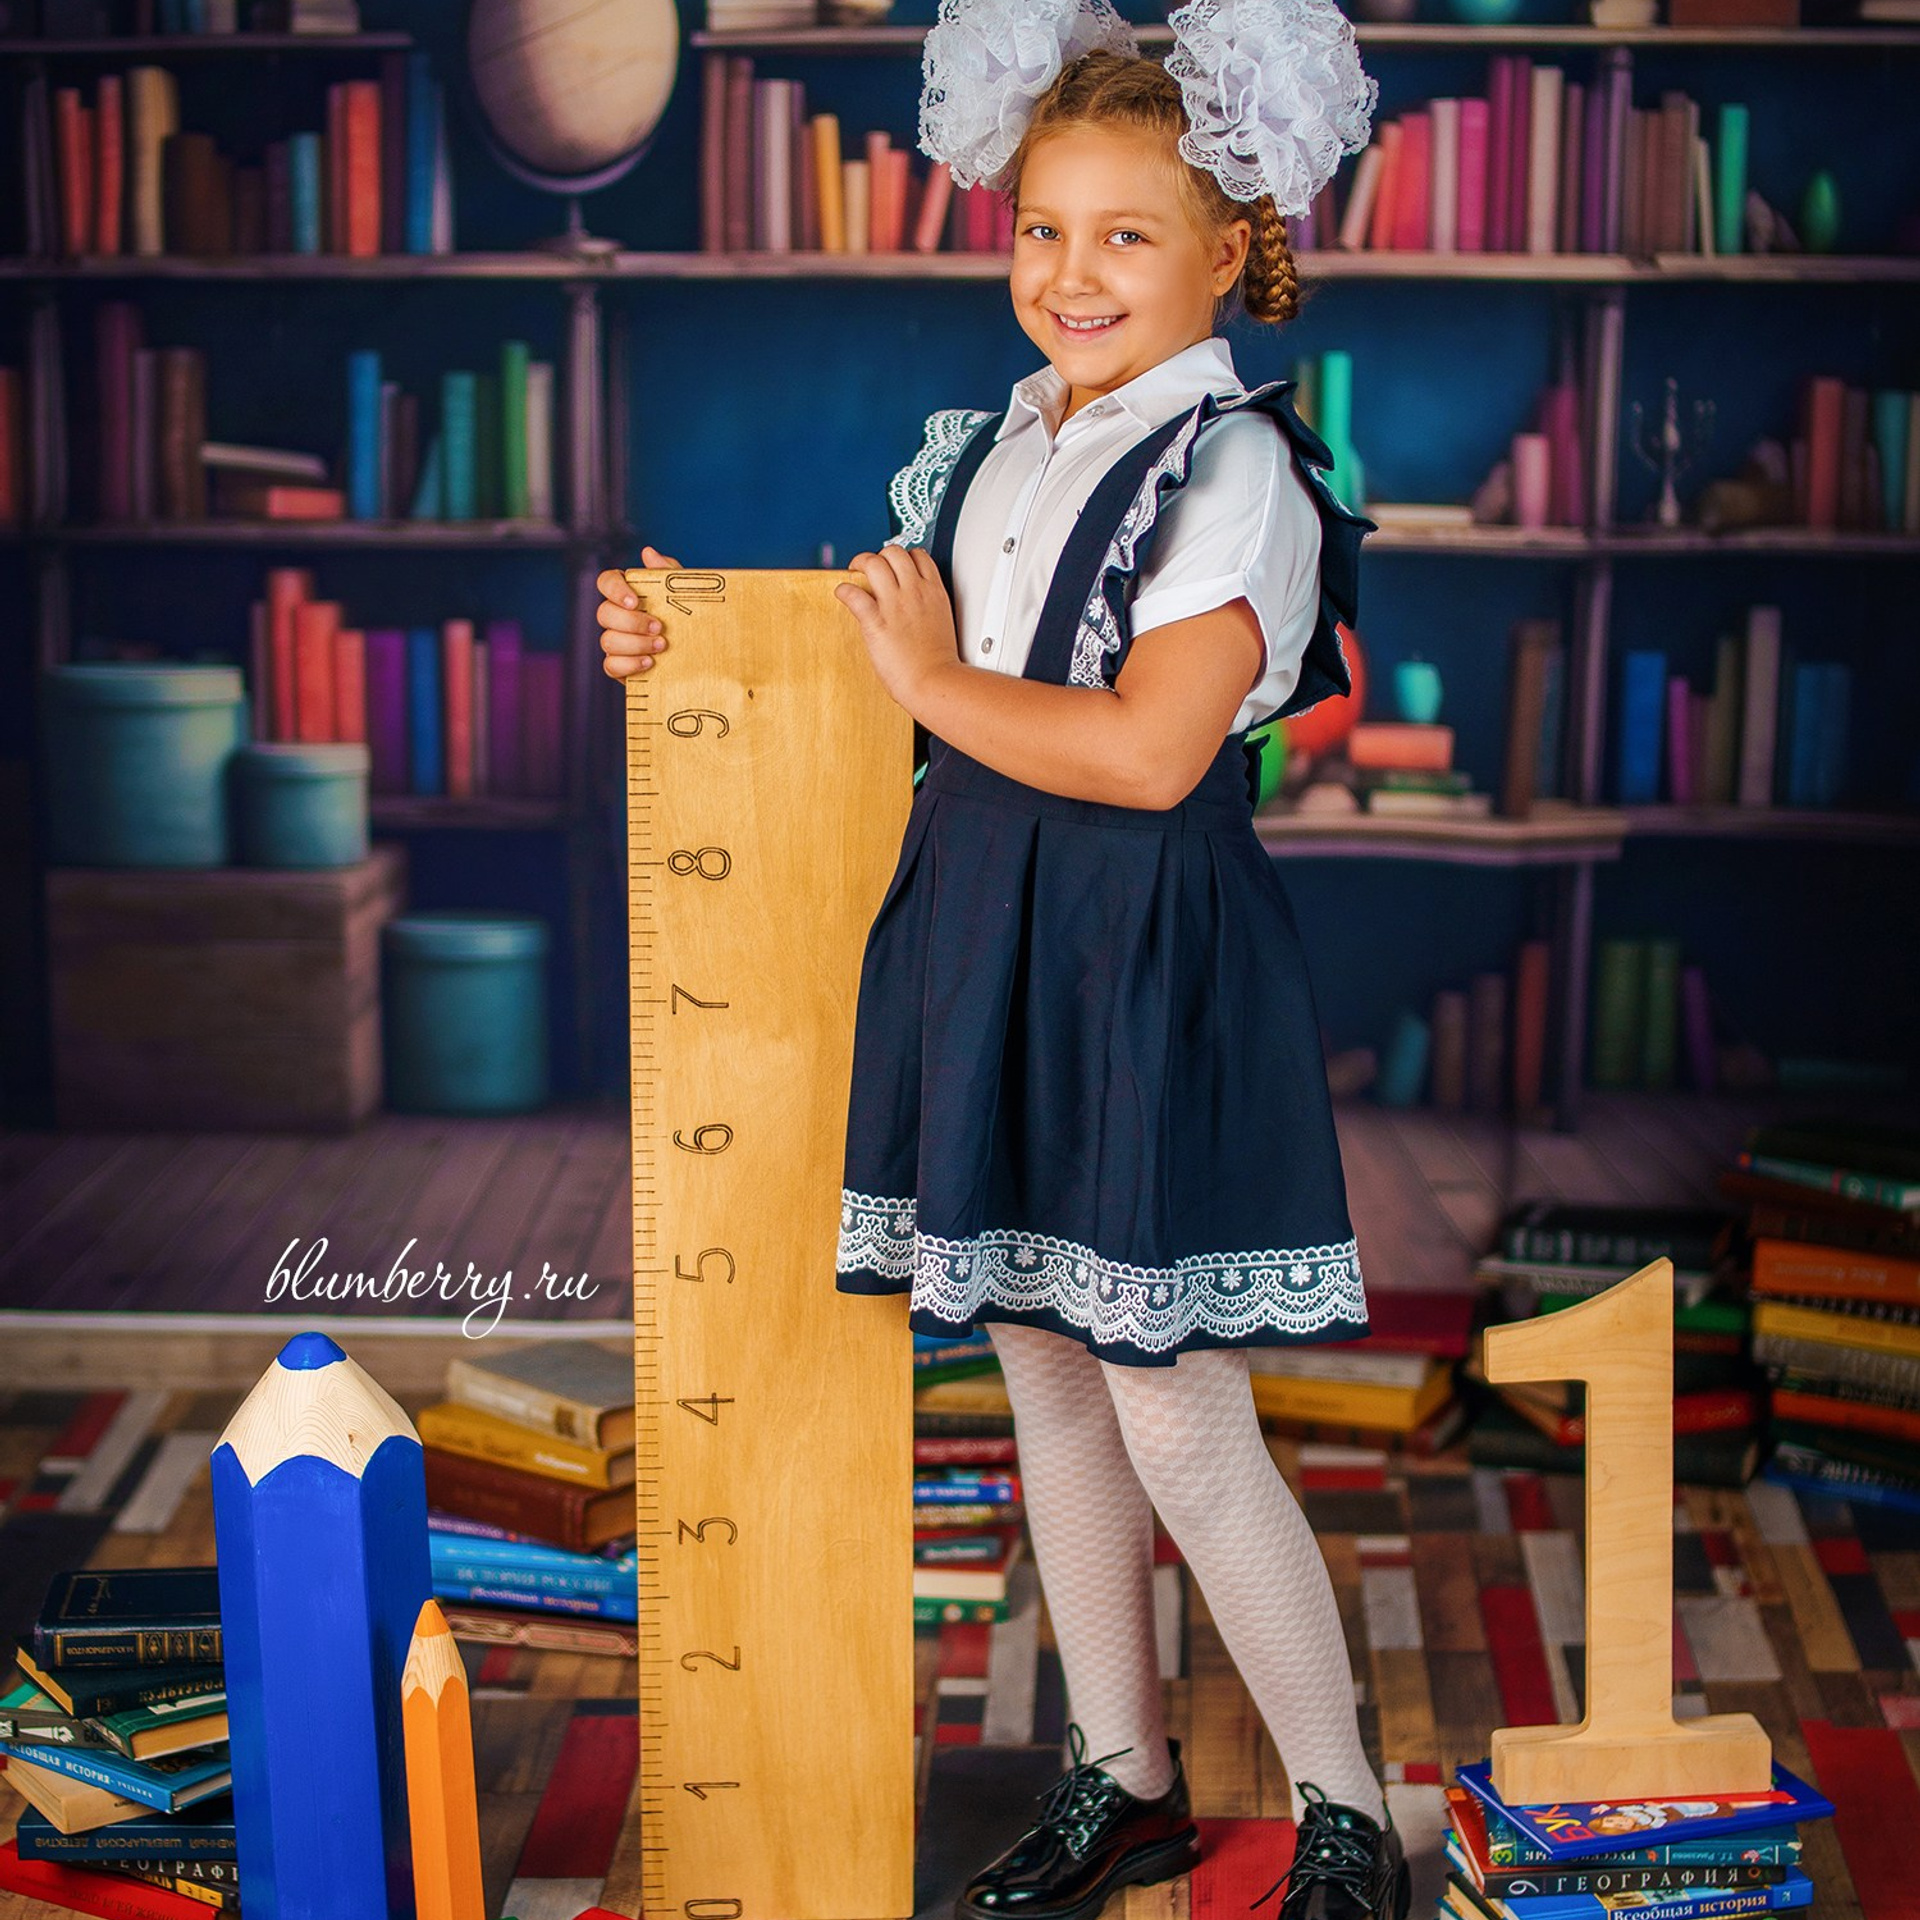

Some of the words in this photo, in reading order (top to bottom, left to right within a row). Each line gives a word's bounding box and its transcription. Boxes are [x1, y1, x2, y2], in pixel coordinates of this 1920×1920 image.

[664, 572, 726, 616] 10
[666, 707, 731, 739] 9
[667, 845, 732, 881] 8
[671, 983, 730, 1015] 7
[672, 1122, 735, 1156] 6
[675, 1247, 737, 1285] 5
[676, 1392, 737, 1427] 4
[678, 1517, 739, 1546] 3
[681, 1645, 741, 1673] 2
[683, 1780, 741, 1800] 1
[1520, 1803, 1596, 1843] БУК
[1556, 1867, 1739, 1893] ГЕОГРАФИЯ
[684, 1898, 743, 1920] 0
[1613, 1903, 1694, 1920] Всеобщая
[1699, 1894, 1768, 1913] история
